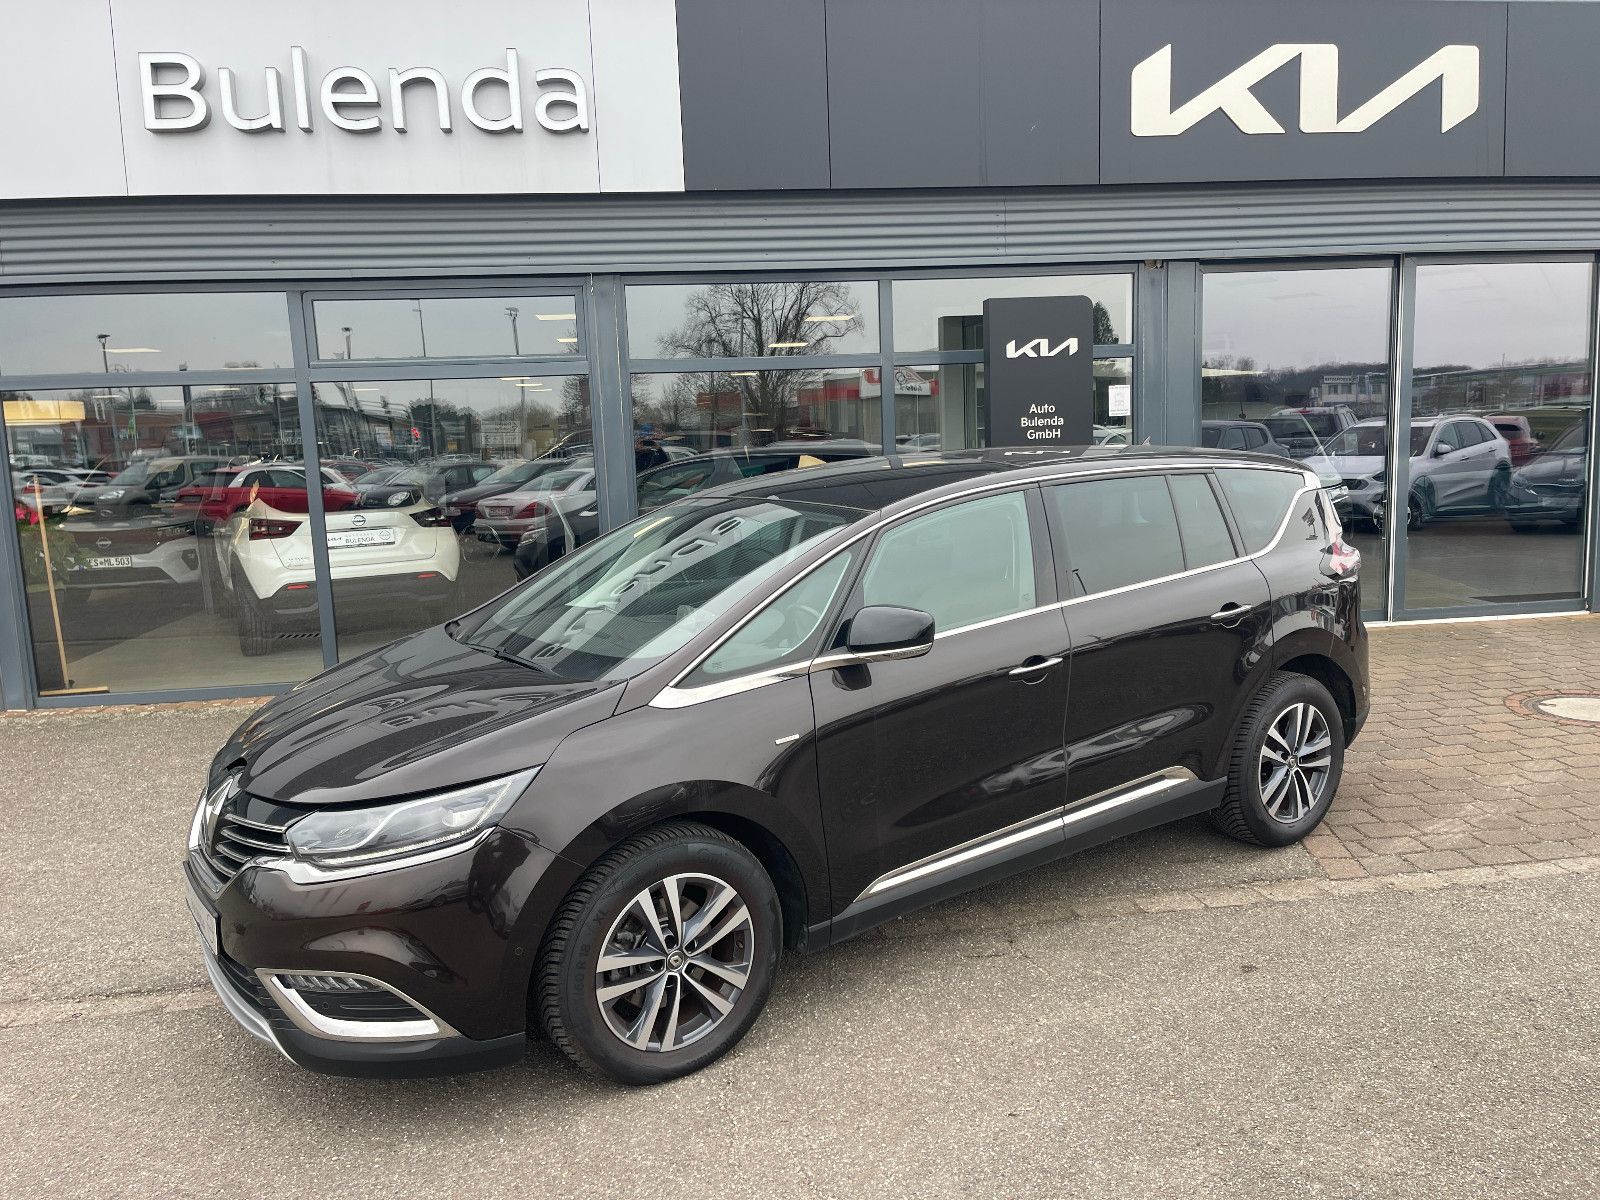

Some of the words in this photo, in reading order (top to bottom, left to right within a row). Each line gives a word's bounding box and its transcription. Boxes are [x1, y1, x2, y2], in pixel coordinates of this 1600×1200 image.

[138, 46, 590, 133] Bulenda
[1131, 43, 1480, 136] KIA
[1006, 337, 1079, 359] KIA
[1029, 403, 1056, 414] Auto
[1020, 416, 1064, 428] Bulenda
[1026, 429, 1061, 440] GmbH
[345, 536, 375, 544] BULENDA
[103, 558, 115, 567] ML
[115, 557, 130, 566] 503
